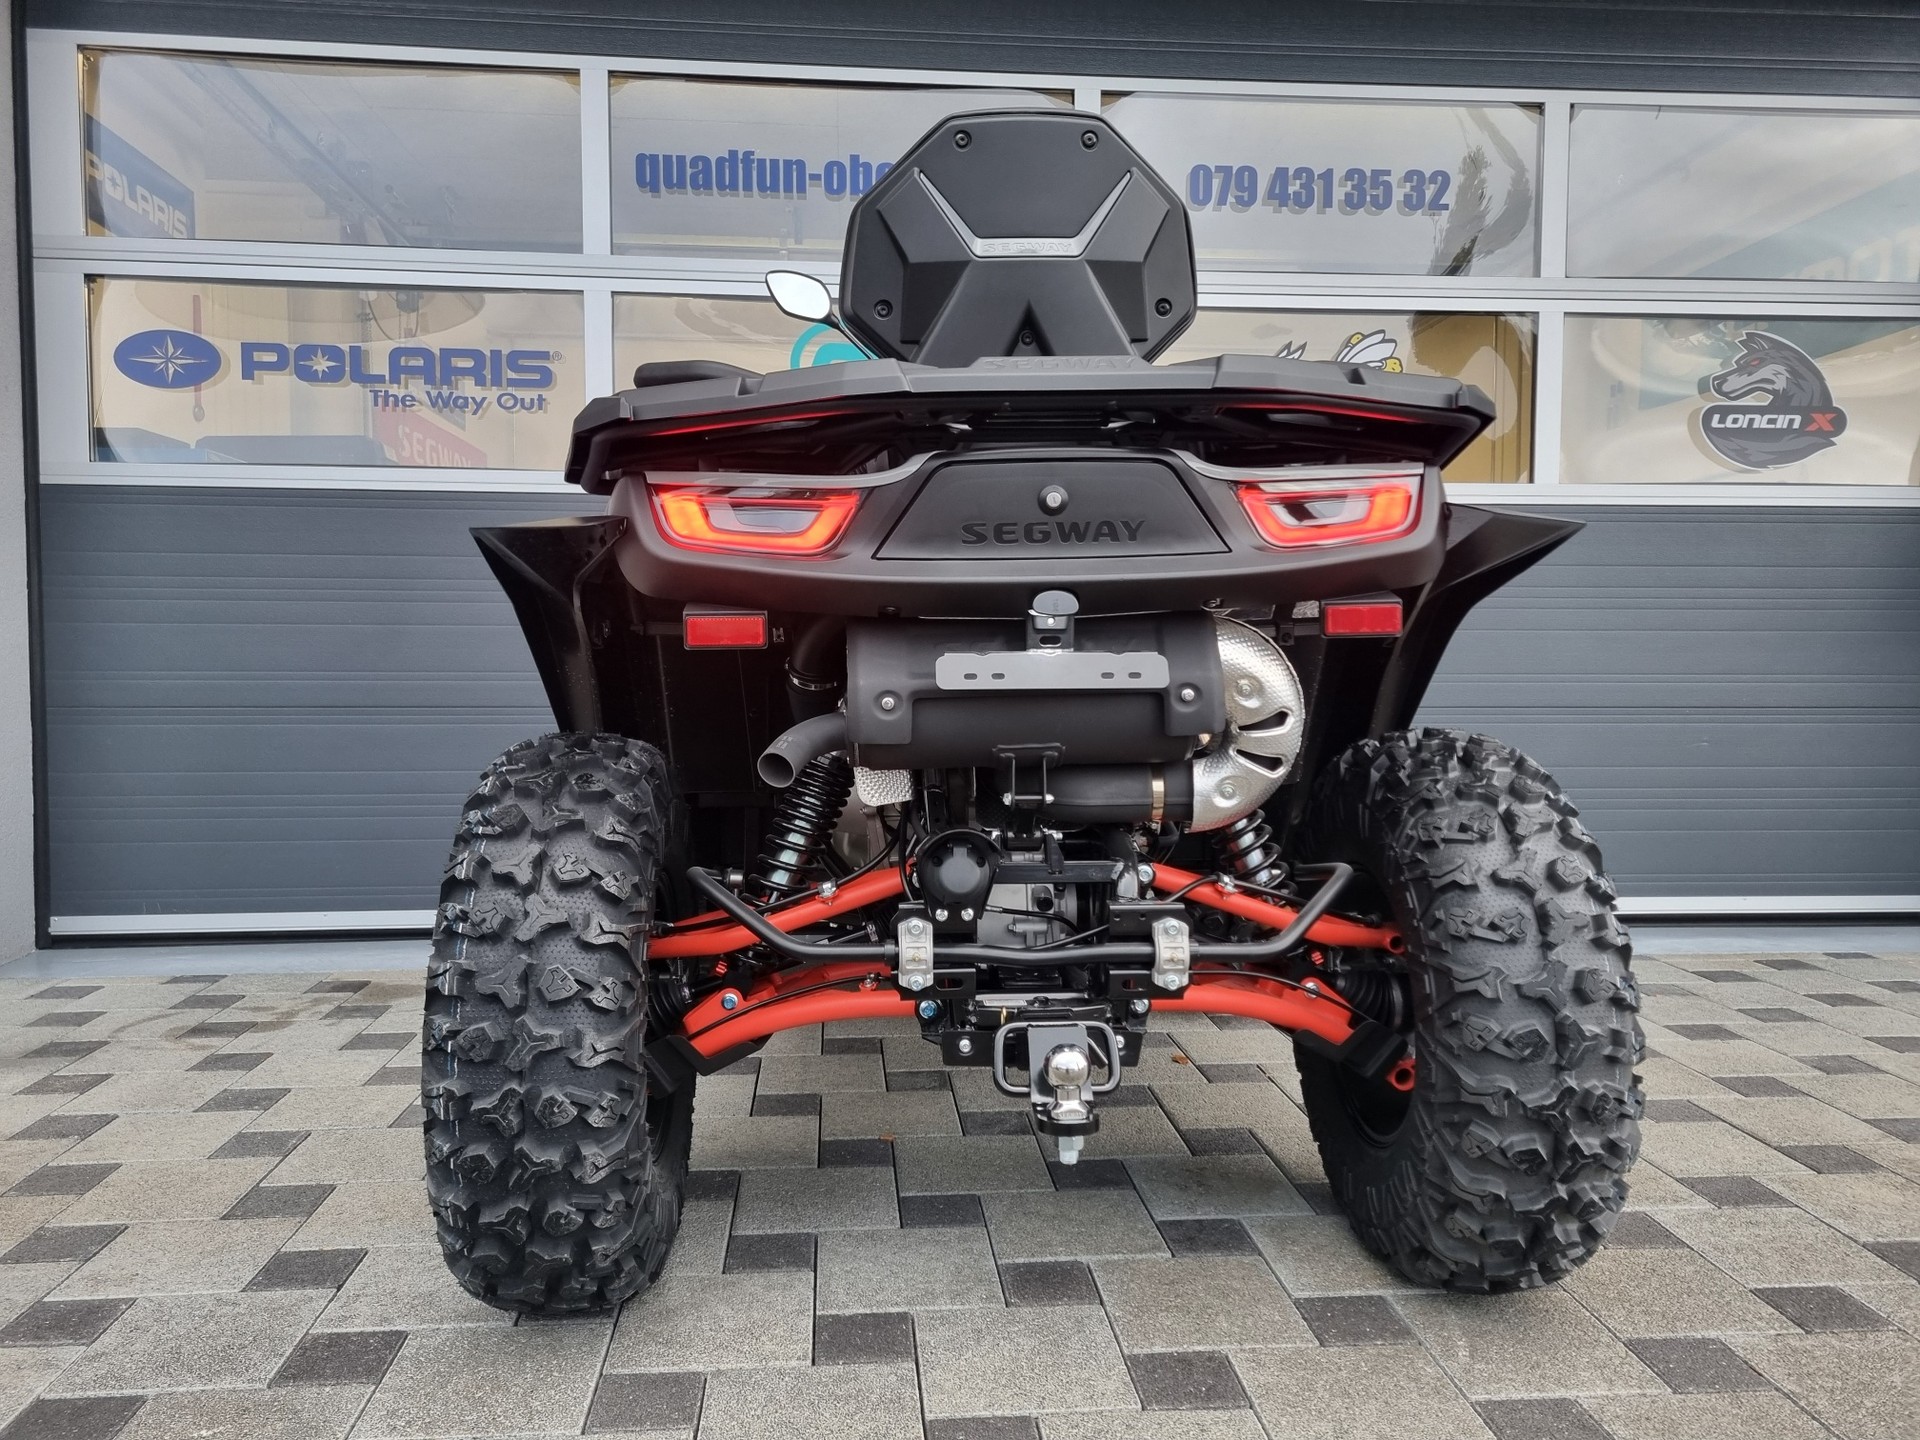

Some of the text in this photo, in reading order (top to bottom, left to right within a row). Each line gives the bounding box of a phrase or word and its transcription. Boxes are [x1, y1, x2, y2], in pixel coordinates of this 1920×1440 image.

[86, 149, 188, 238] POLARIS
[1189, 164, 1451, 211] 079 431 35 32
[983, 242, 1072, 253] SEGWAY
[980, 358, 1137, 370] SEGWAY
[369, 389, 546, 416] The Way Out
[1711, 413, 1838, 432] LONCIN X
[961, 520, 1146, 545] SEGWAY
